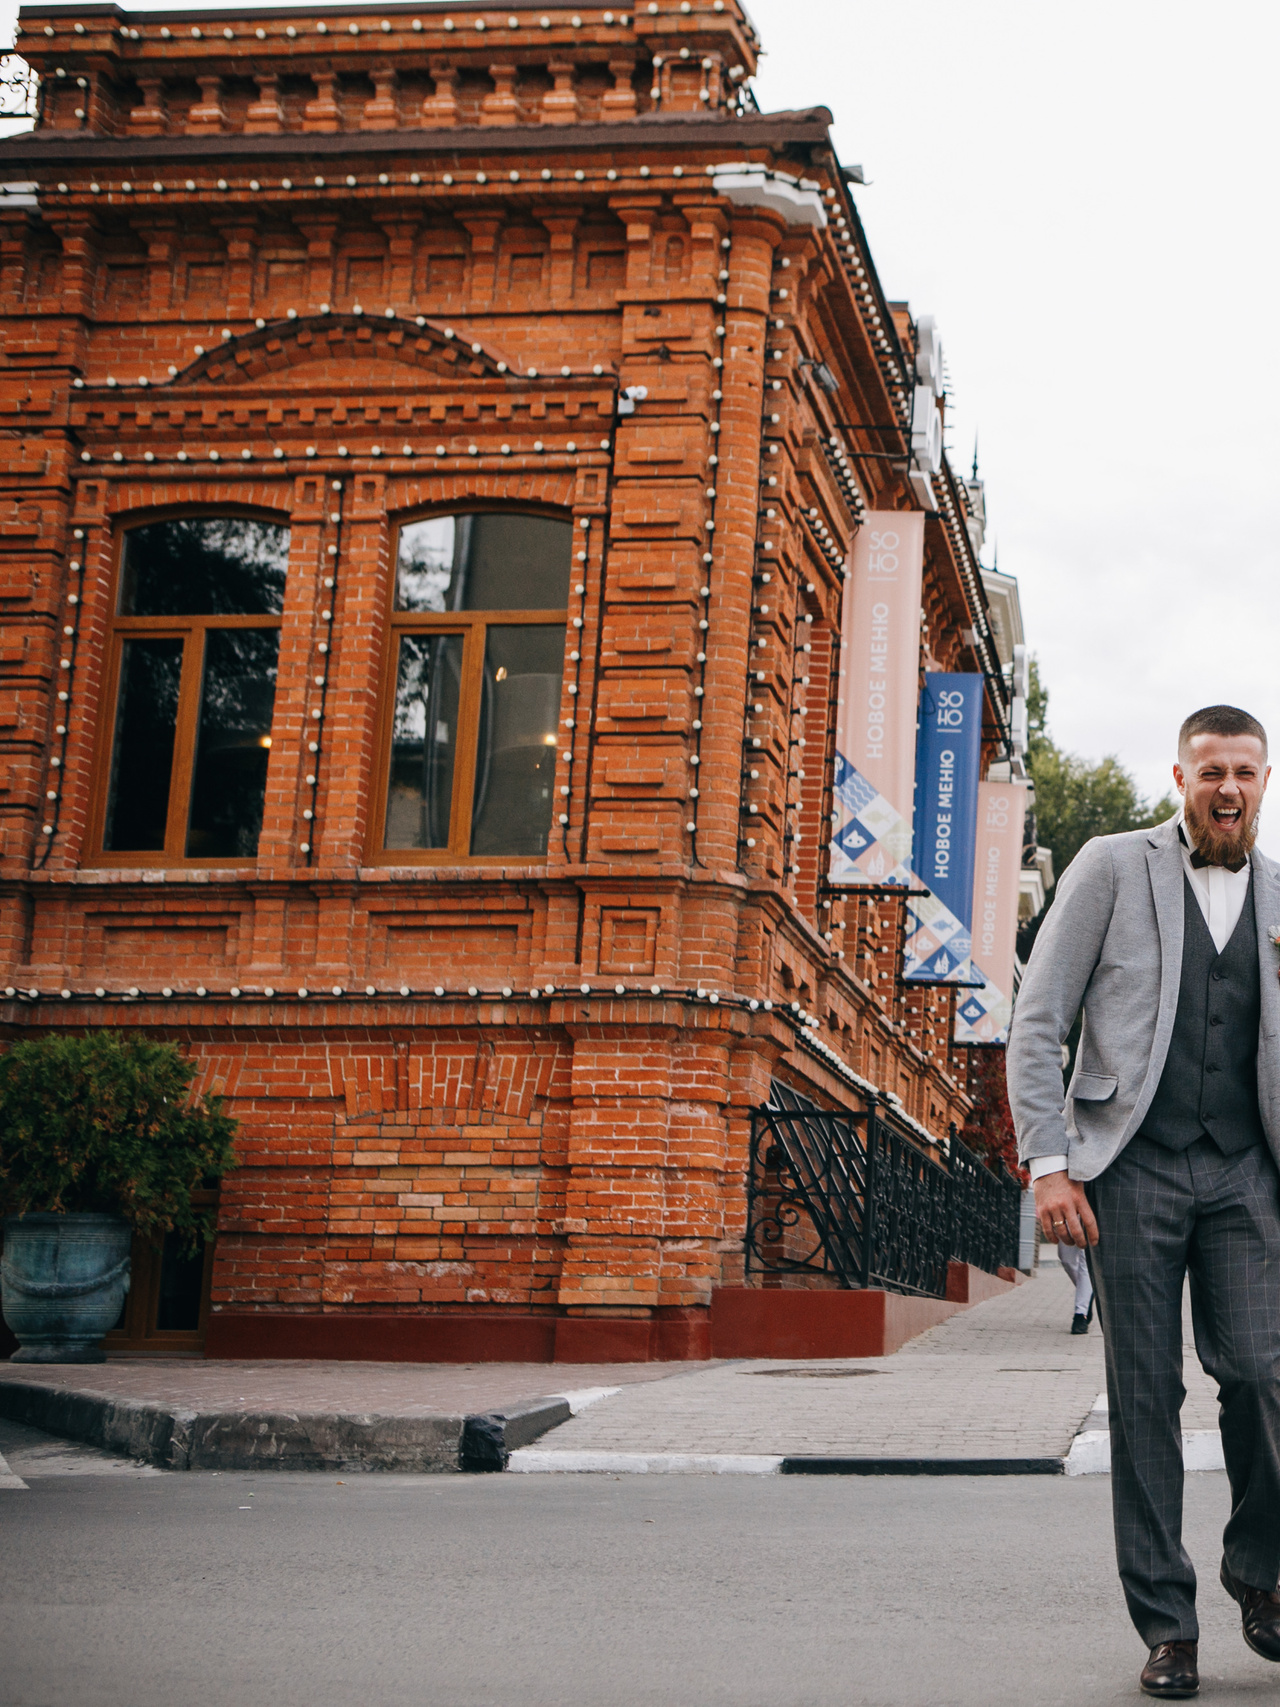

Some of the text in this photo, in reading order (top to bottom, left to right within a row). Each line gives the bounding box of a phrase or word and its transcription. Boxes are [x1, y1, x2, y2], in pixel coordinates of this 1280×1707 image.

[868, 531, 899, 551] SO
[868, 553, 899, 573] HO
[866, 602, 890, 759] НОВОЕ МЕНЮ
[938, 691, 964, 708] SO
[937, 709, 963, 726] HO
[988, 796, 1009, 811] SO
[934, 750, 955, 878] НОВОЕ МЕНЮ
[986, 812, 1009, 827] HO
[981, 847, 1001, 956] НОВОЕ МЕНЮ
